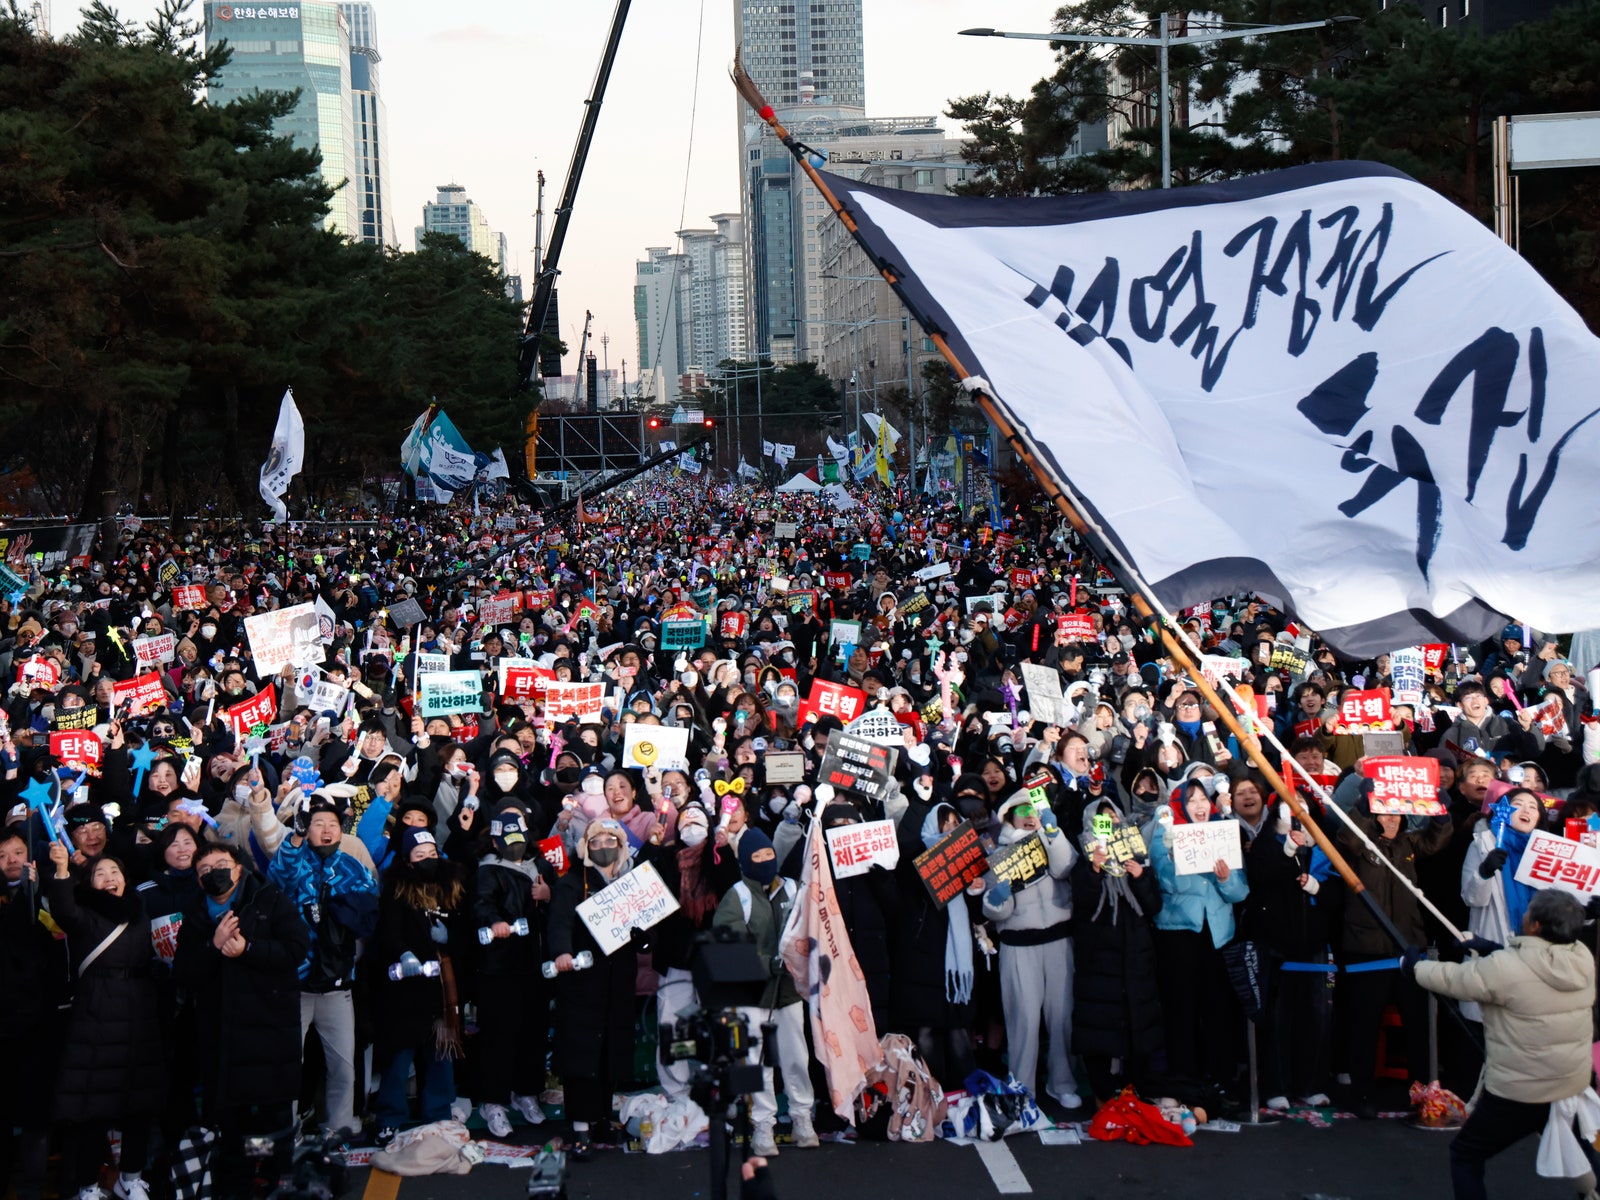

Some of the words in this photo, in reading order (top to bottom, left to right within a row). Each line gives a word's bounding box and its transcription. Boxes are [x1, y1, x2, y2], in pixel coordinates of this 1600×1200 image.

[233, 7, 299, 19] 한화손해보험
[1223, 202, 1455, 358] 정권
[666, 635, 701, 646] 해산하라
[667, 626, 701, 637] 국민의힘
[428, 694, 478, 709] 해산하라
[546, 684, 602, 702] 윤석열을
[241, 696, 272, 729] 탄핵
[547, 699, 602, 717] 구속하라
[819, 690, 858, 719] 탄핵
[1342, 697, 1383, 722] 탄핵
[60, 737, 100, 762] 탄핵
[1378, 765, 1428, 783] 내란수괴
[1099, 820, 1111, 835] 핵
[832, 832, 861, 848] 내란범
[544, 845, 564, 871] 핵
[834, 836, 895, 867] 체포하라
[929, 869, 950, 890] 집회
[1529, 855, 1600, 892] 탄핵!
[936, 877, 964, 904] 케이팝
[587, 903, 616, 926] 언니가
